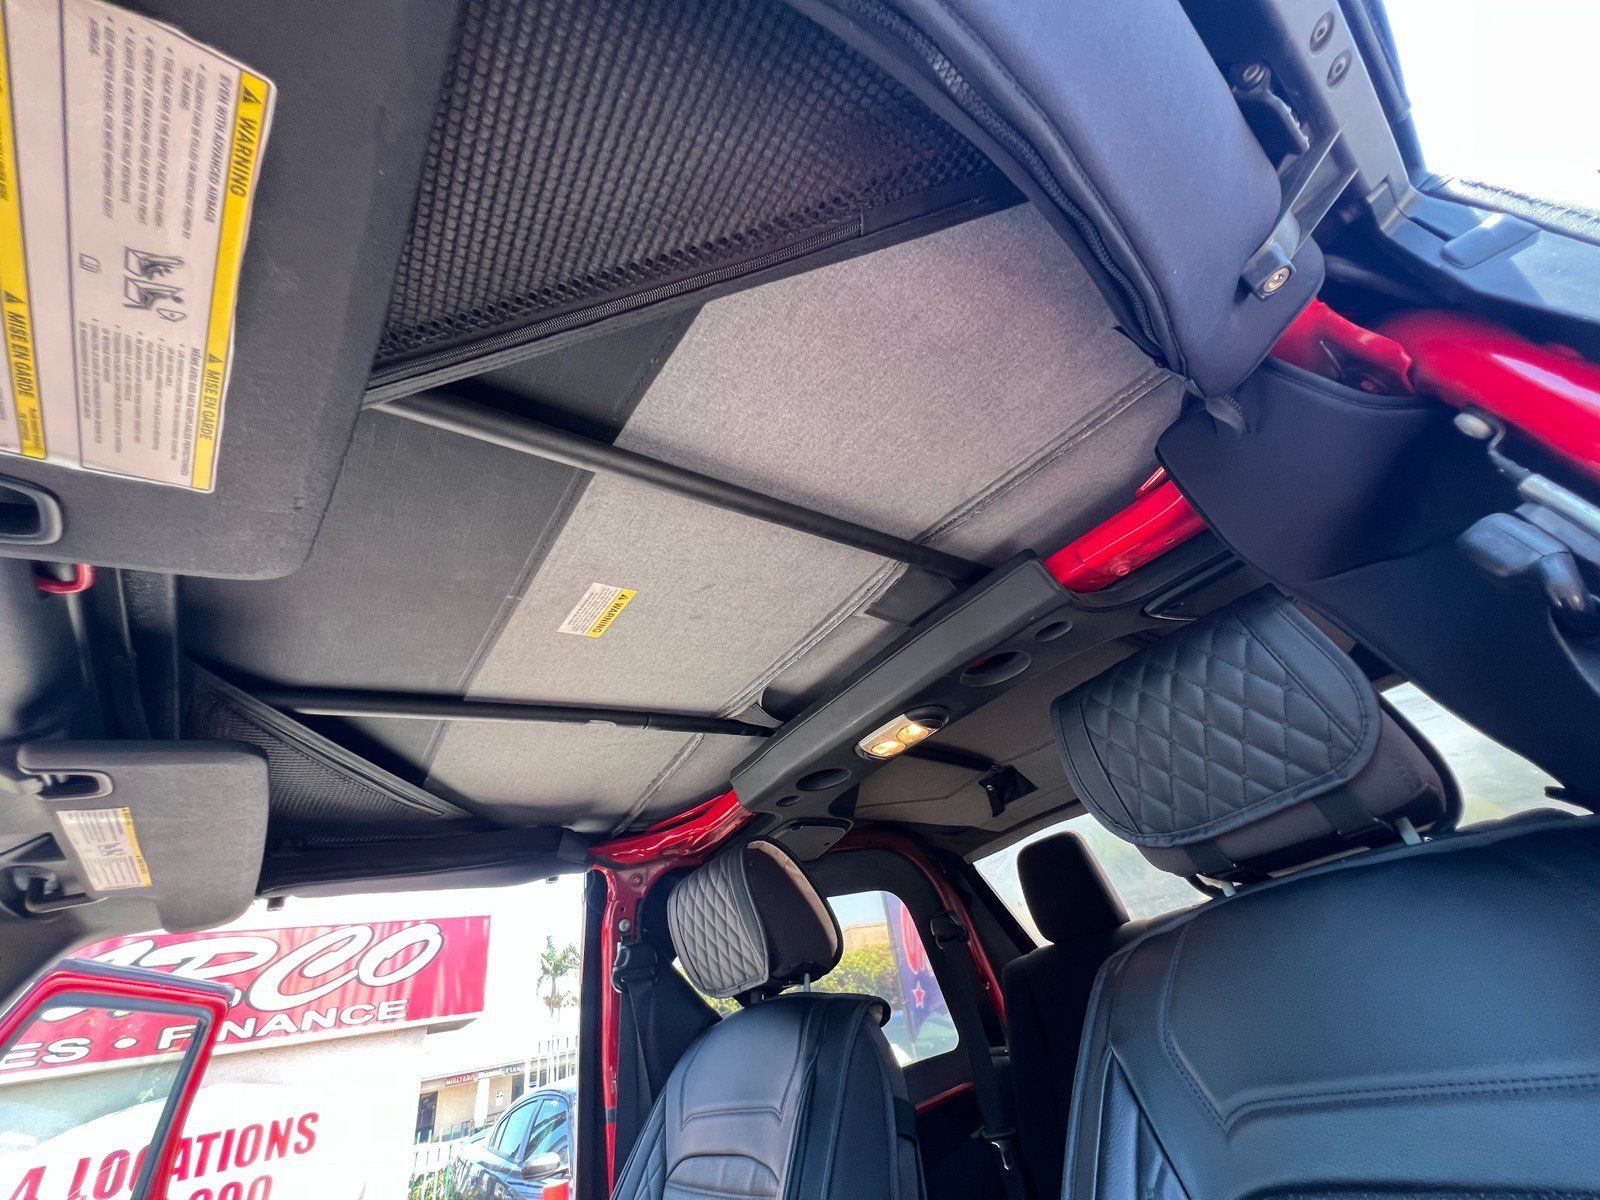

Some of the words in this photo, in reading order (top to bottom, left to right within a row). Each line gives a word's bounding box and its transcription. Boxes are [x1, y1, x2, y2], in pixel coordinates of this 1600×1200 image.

[216, 72, 231, 105] EVEN
[213, 101, 228, 134] WITH
[208, 130, 225, 186] ADVANCED
[230, 115, 257, 199] WARNING
[7, 310, 27, 343] MISE
[12, 342, 32, 361] EN
[15, 361, 36, 400] GARDE
[204, 369, 221, 395] MISE
[203, 394, 217, 409] EN
[199, 409, 215, 440] GARDE
[593, 603, 624, 633] WARNING
[156, 998, 409, 1051] FNANCE
